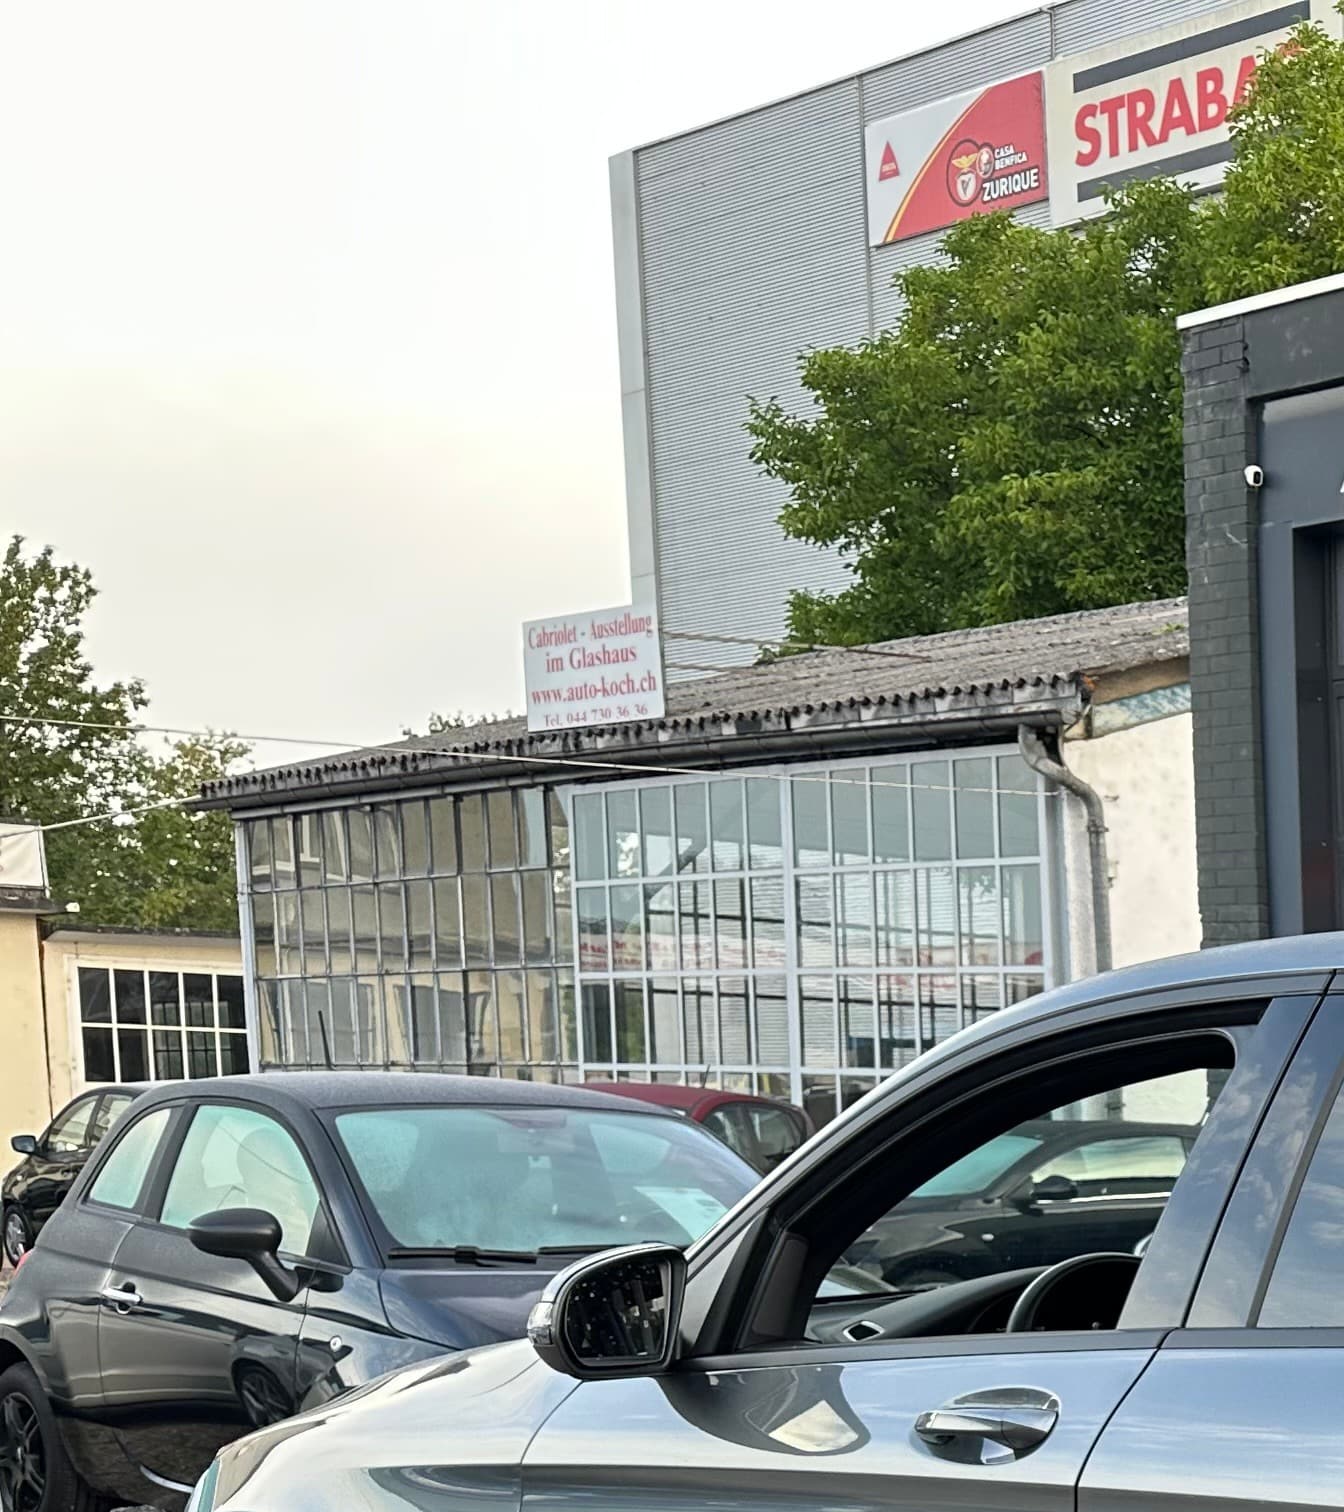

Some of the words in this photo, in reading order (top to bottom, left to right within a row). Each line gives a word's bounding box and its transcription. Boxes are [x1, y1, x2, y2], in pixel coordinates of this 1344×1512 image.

[1074, 40, 1302, 167] STRABA
[994, 144, 1015, 159] CASA
[995, 152, 1028, 170] BENFICA
[982, 168, 1040, 202] ZURIQUE
[528, 623, 578, 650] Cabriolet
[590, 612, 653, 640] Ausstellung
[546, 653, 564, 673] im
[569, 643, 637, 670] Glashaus
[531, 670, 657, 704] www.auto-koch.ch
[567, 713, 587, 724] 044
